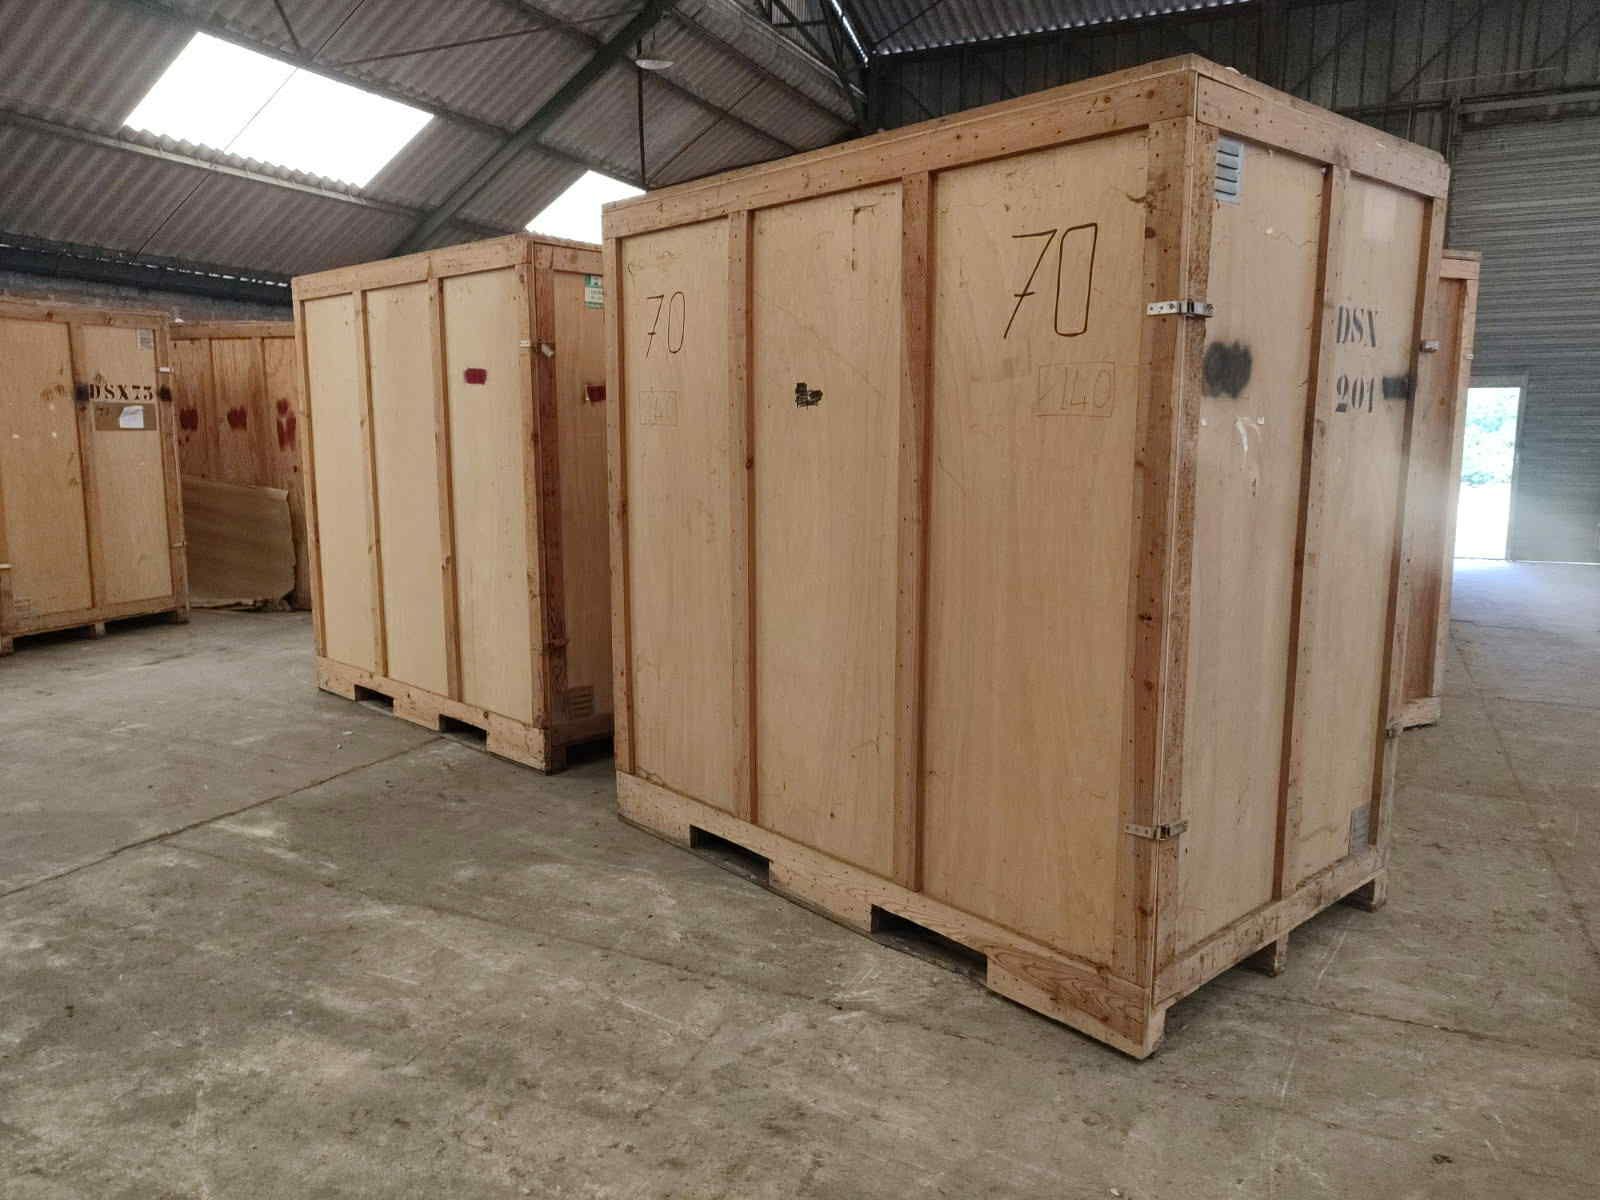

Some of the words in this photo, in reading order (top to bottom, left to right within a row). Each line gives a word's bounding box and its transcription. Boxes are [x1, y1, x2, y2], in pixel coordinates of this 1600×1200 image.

[1003, 223, 1098, 338] 70
[646, 291, 686, 359] 70
[1336, 305, 1378, 348] DSX
[1335, 374, 1375, 413] 201
